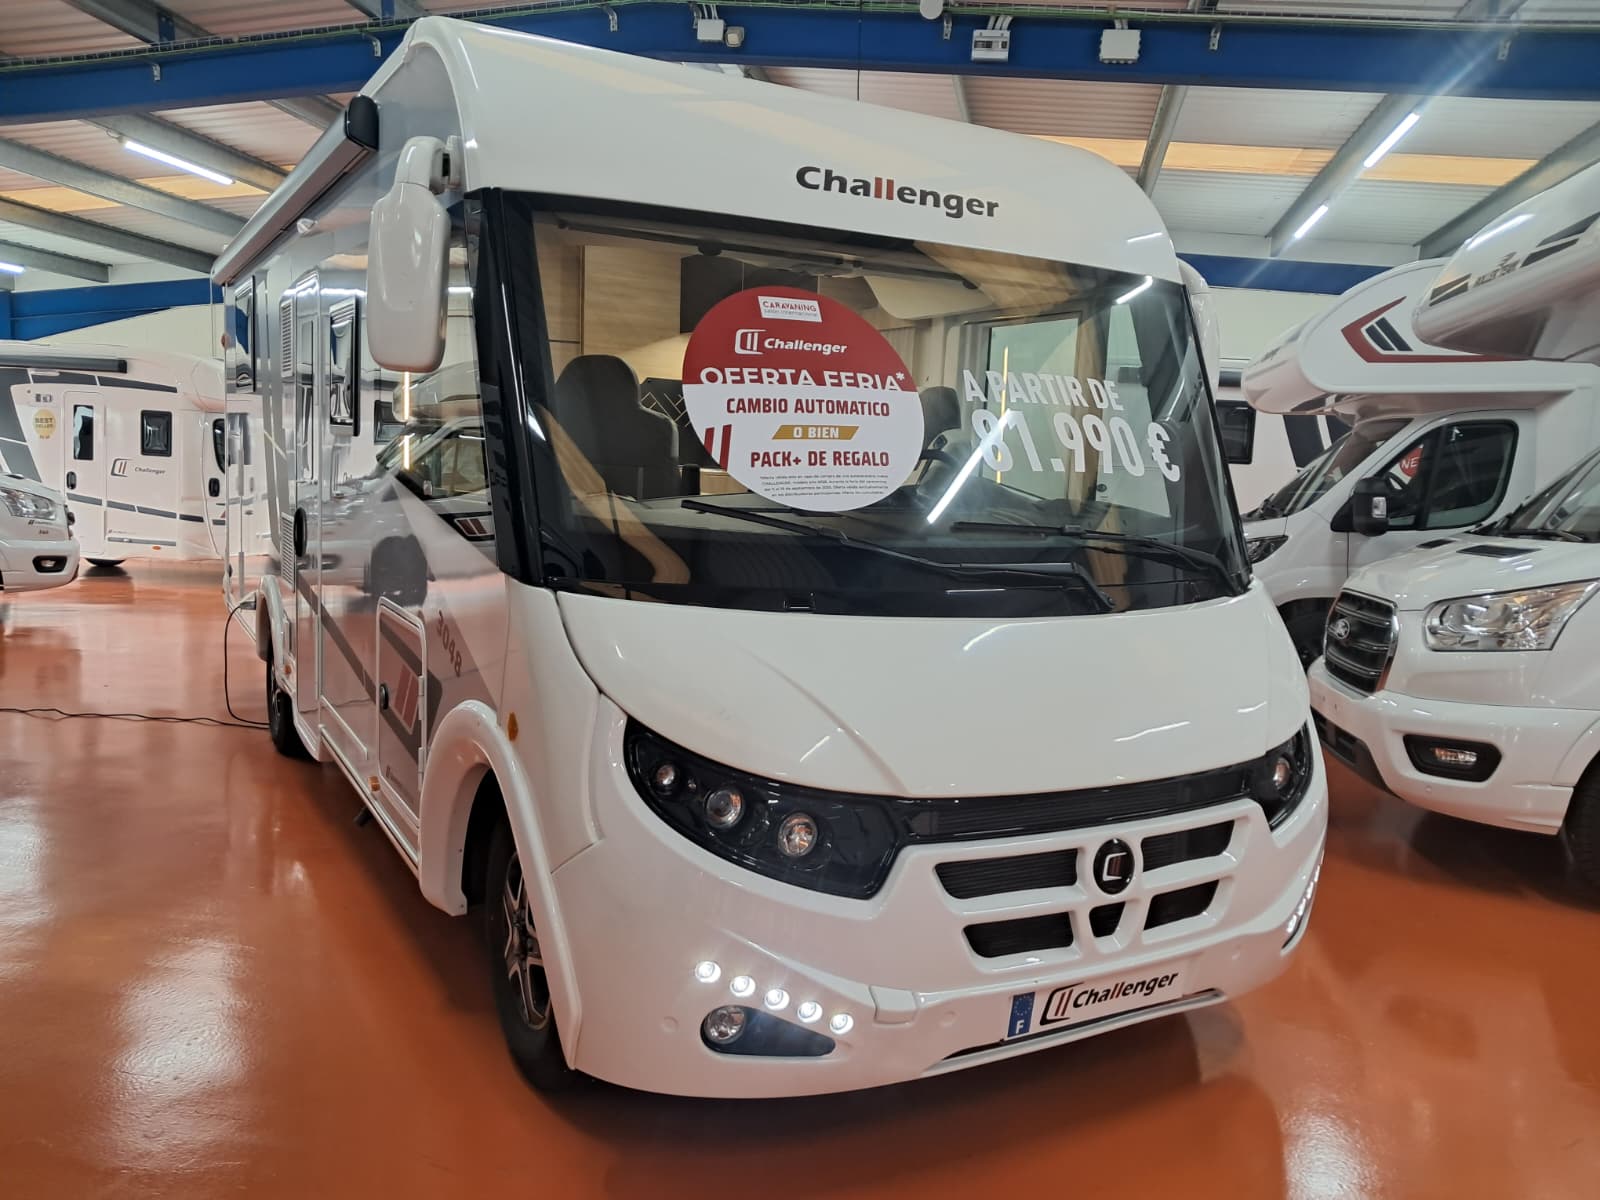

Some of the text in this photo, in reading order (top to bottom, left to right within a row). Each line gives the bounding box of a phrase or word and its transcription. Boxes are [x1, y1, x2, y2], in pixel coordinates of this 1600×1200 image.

[796, 166, 999, 218] Challenger
[762, 300, 817, 312] CARAVANING
[763, 337, 848, 356] Challenger
[700, 367, 817, 386] OFERTA
[963, 369, 1124, 411] A PARTIR DE
[726, 398, 890, 417] CAMBIO AUTOMATICO
[793, 427, 839, 439] O BIEN
[972, 408, 1181, 482] 81.990 €
[750, 450, 890, 468] PACK+ DE REGALO
[436, 609, 462, 679] 3048
[1015, 972, 1179, 1035] F Challenger
